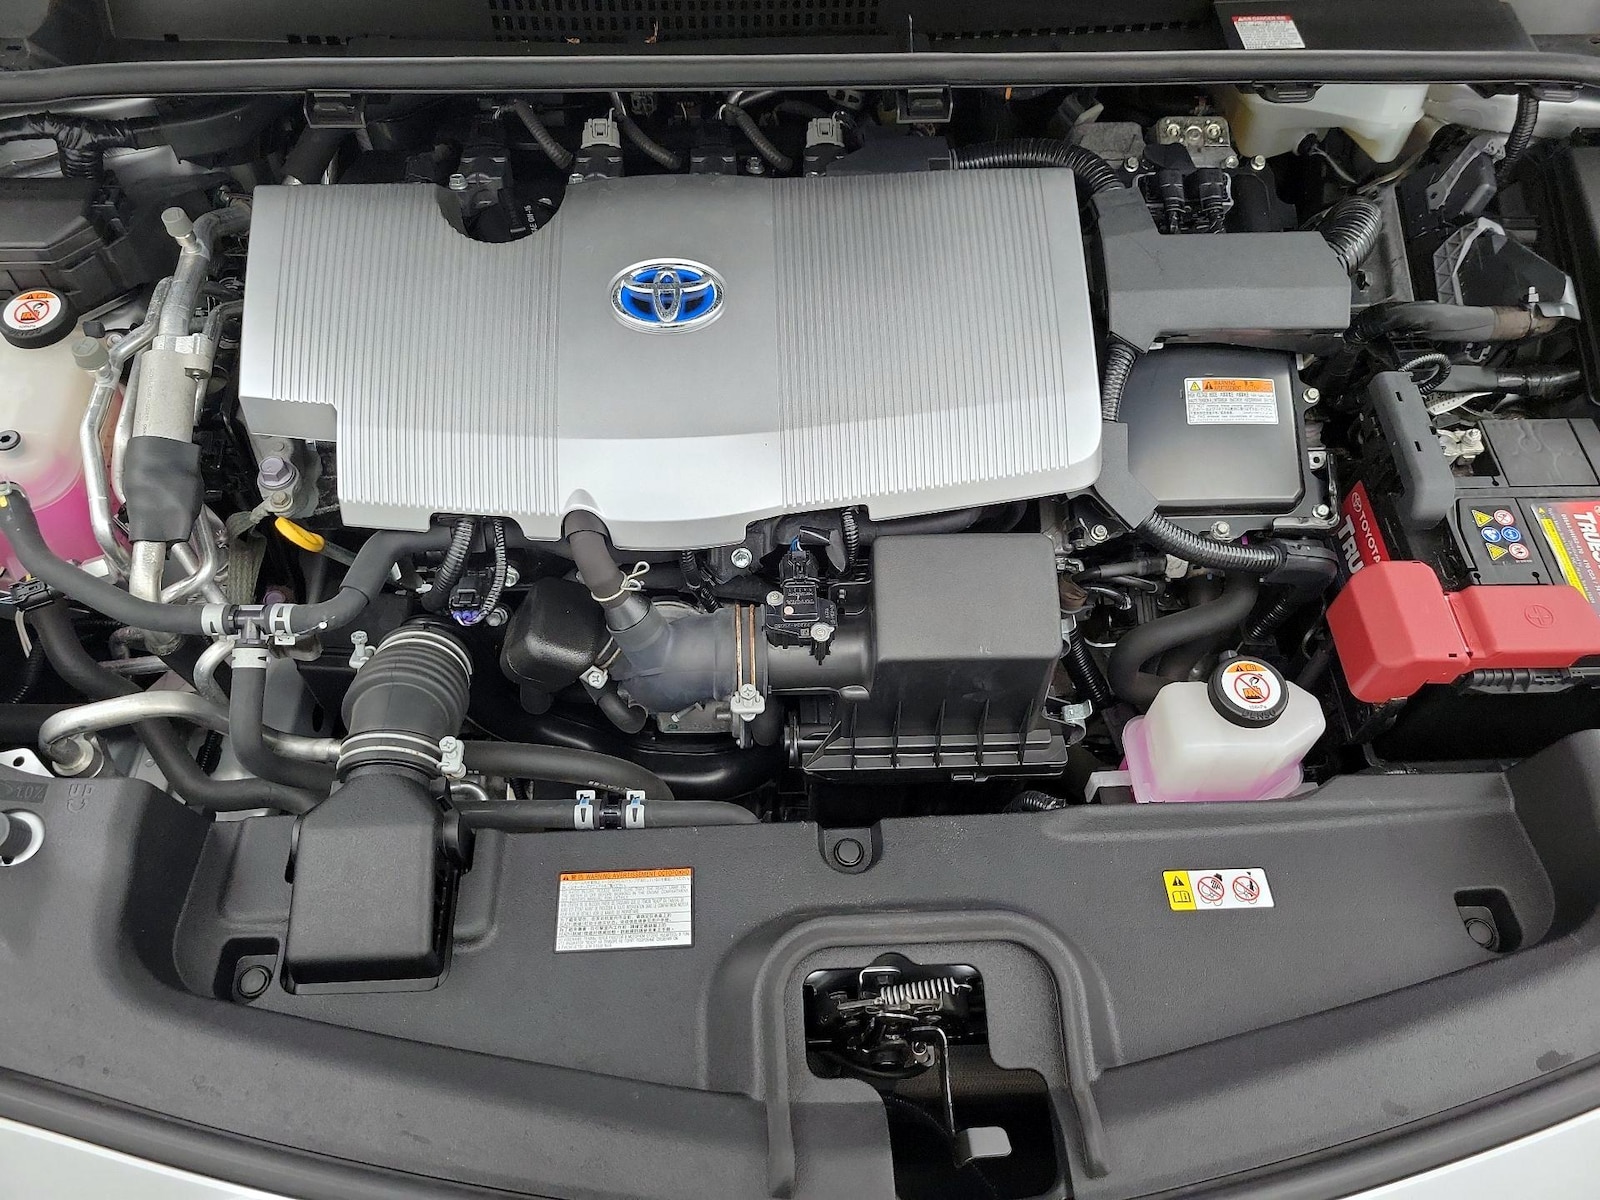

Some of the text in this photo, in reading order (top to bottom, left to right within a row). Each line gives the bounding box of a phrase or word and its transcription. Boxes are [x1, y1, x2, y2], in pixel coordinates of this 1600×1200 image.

[1338, 514, 1364, 574] TRU
[1359, 510, 1381, 563] TOYOTA
[1242, 708, 1276, 720] DENSO
[68, 783, 95, 797] UP
